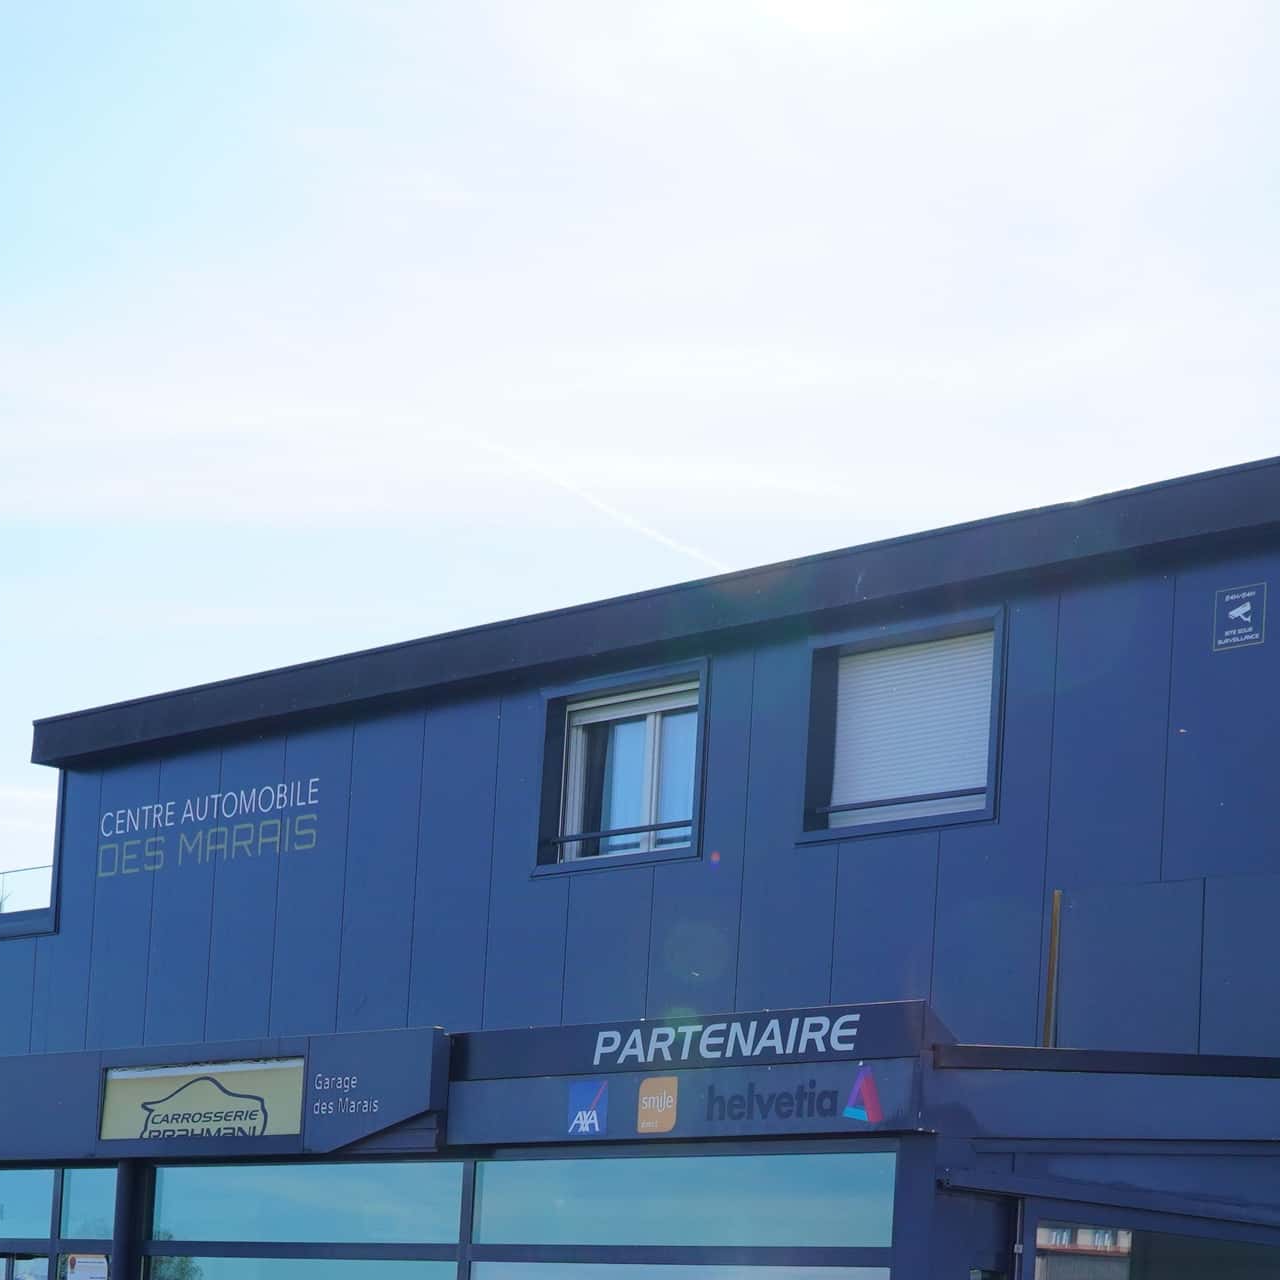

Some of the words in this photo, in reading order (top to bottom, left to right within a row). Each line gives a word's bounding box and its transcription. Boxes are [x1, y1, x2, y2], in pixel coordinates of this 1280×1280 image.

[100, 801, 176, 838] CENTRE
[181, 778, 320, 825] AUTOMOBILE
[96, 836, 166, 878] DES
[177, 813, 319, 867] MARAIS
[593, 1013, 861, 1066] PARTENAIRE
[314, 1073, 358, 1093] Garage
[313, 1099, 334, 1115] des
[337, 1096, 379, 1113] Marais
[641, 1089, 674, 1113] smile
[706, 1079, 839, 1122] helvetia
[151, 1108, 260, 1125] CARROSSERIE
[568, 1109, 600, 1134] AXA
